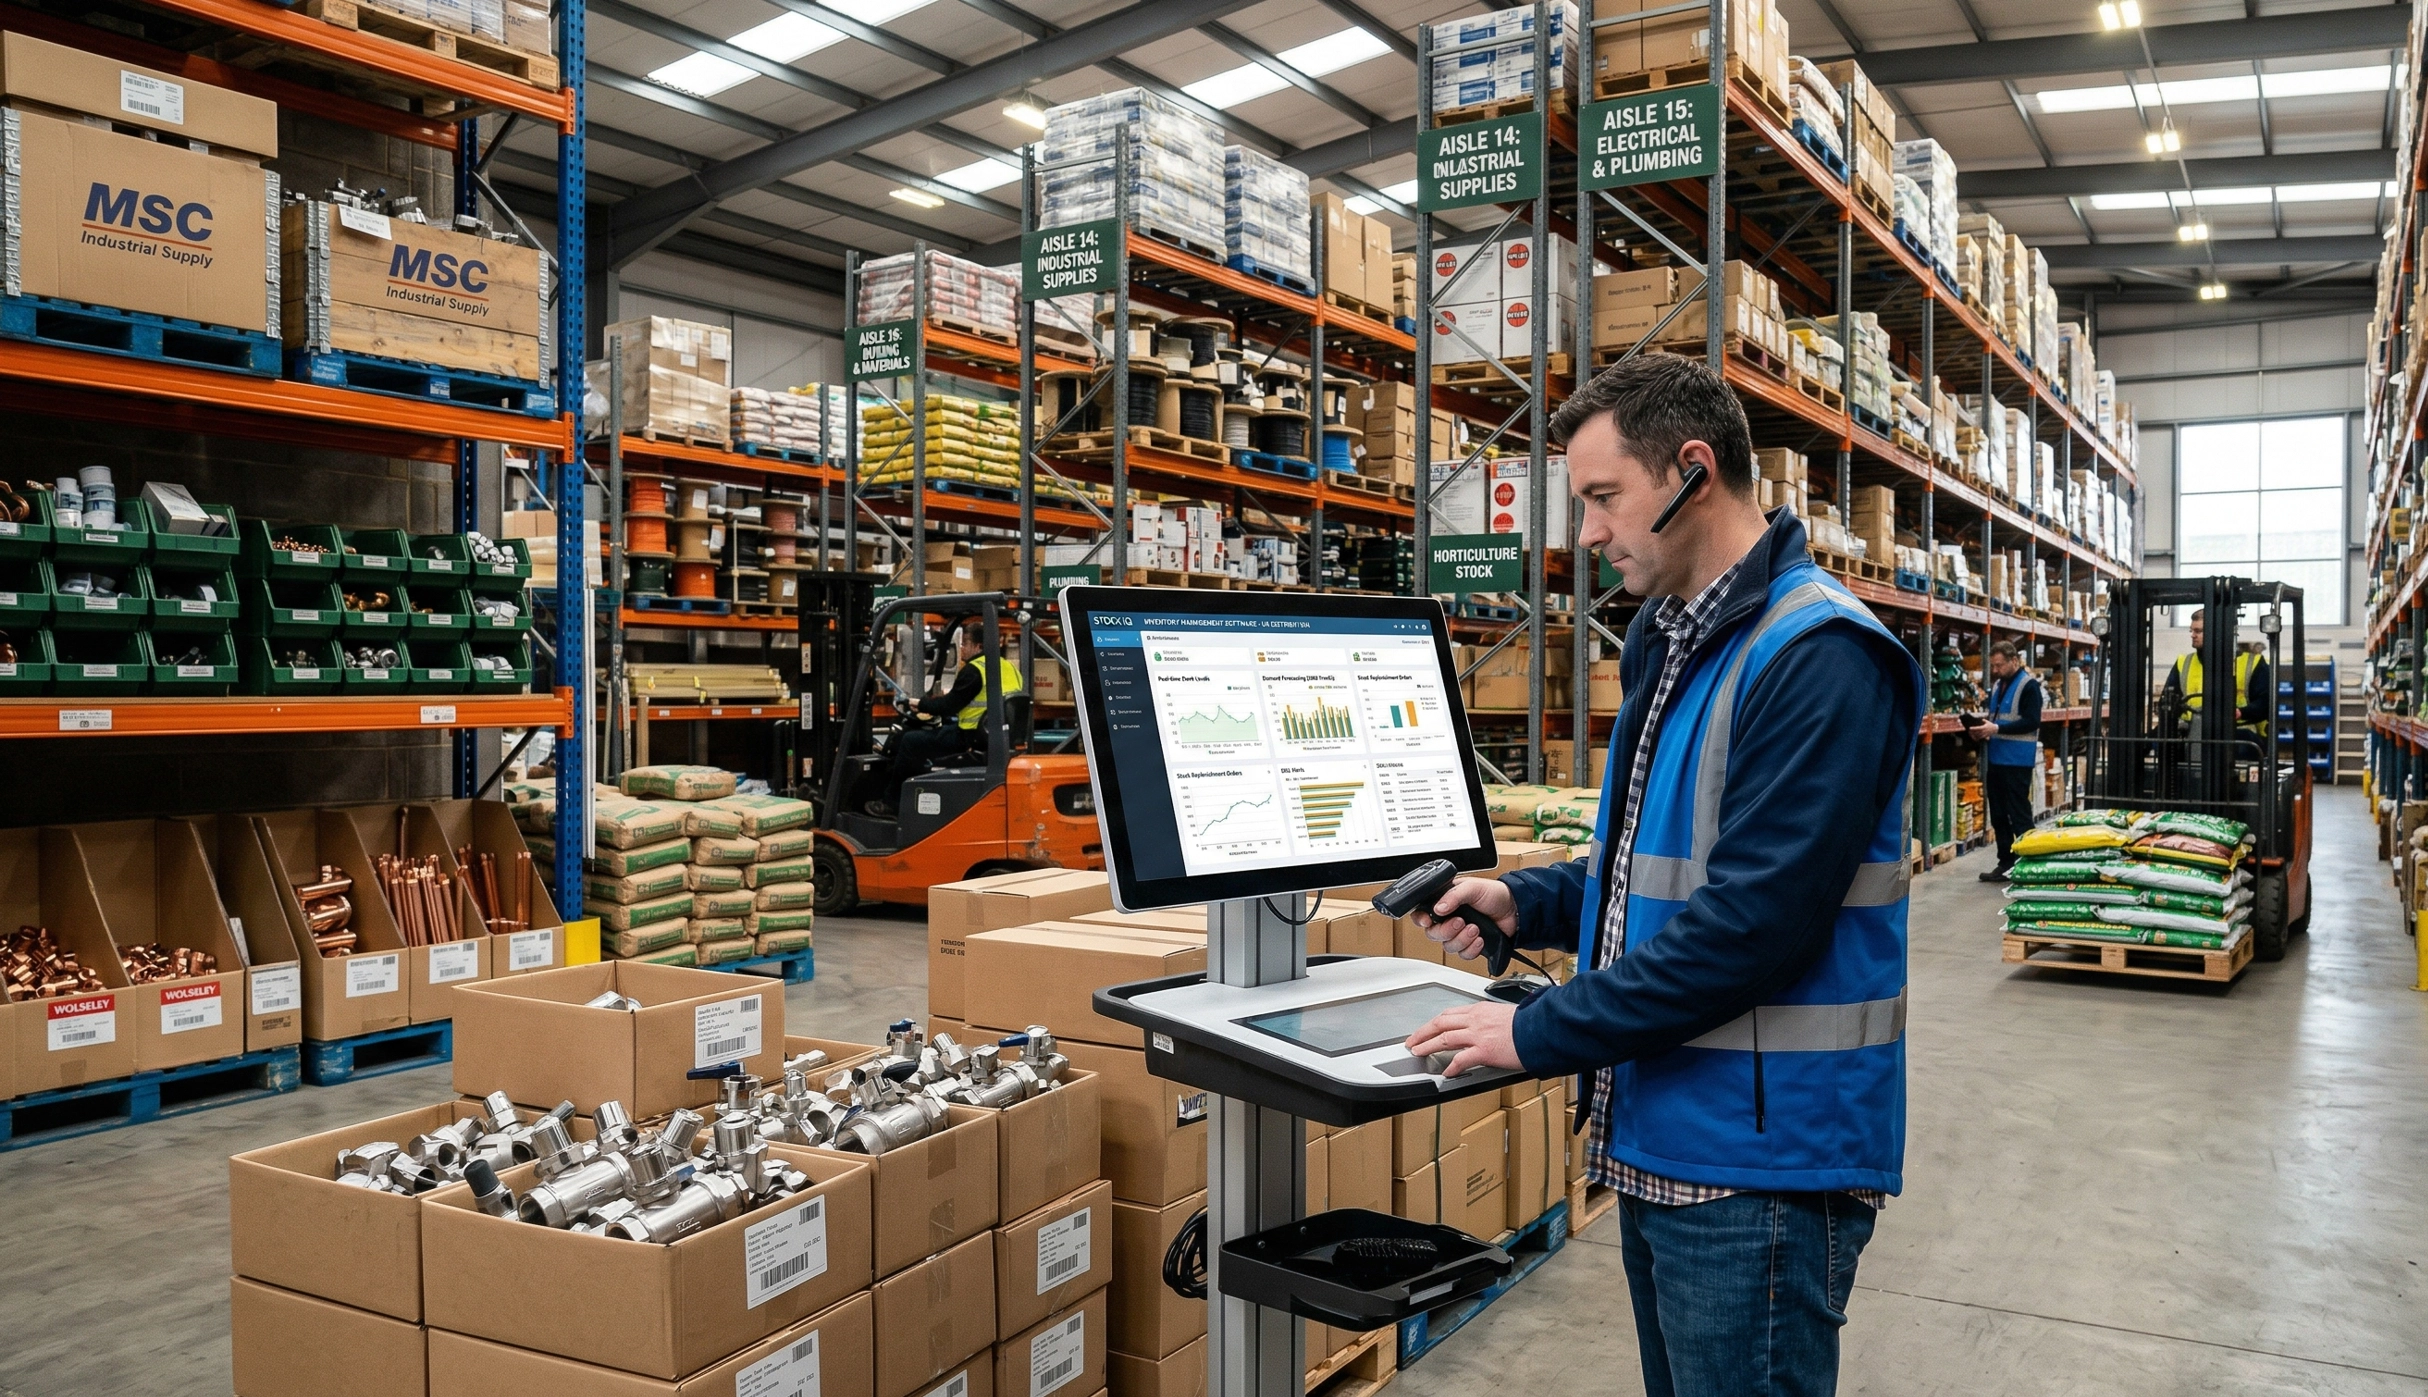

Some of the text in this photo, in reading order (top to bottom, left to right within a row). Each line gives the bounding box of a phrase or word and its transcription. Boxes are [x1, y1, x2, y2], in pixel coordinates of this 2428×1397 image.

[1603, 99, 1694, 131] AISLE 15:
[1439, 125, 1521, 157] AISLE 14:
[1597, 123, 1701, 155] ELECTRICAL
[1592, 145, 1702, 178] & PLUMBING
[1440, 172, 1517, 200] SUPPLIES
[83, 181, 214, 242] MSC
[81, 230, 213, 269] Industrial Supply
[1040, 230, 1099, 254] AISLE 14:
[388, 243, 490, 294] MSC
[1037, 249, 1104, 273] INDUSTRIAL
[1043, 267, 1097, 289] SUPPLIES
[386, 285, 490, 317] Industrial Supply
[859, 329, 886, 346] AISLE
[853, 362, 860, 375] &
[1433, 546, 1518, 563] HORTICULTURE
[1455, 564, 1493, 578] STOCK
[165, 985, 216, 1000] WOLSELEY
[54, 999, 110, 1015] WOLSELEY
